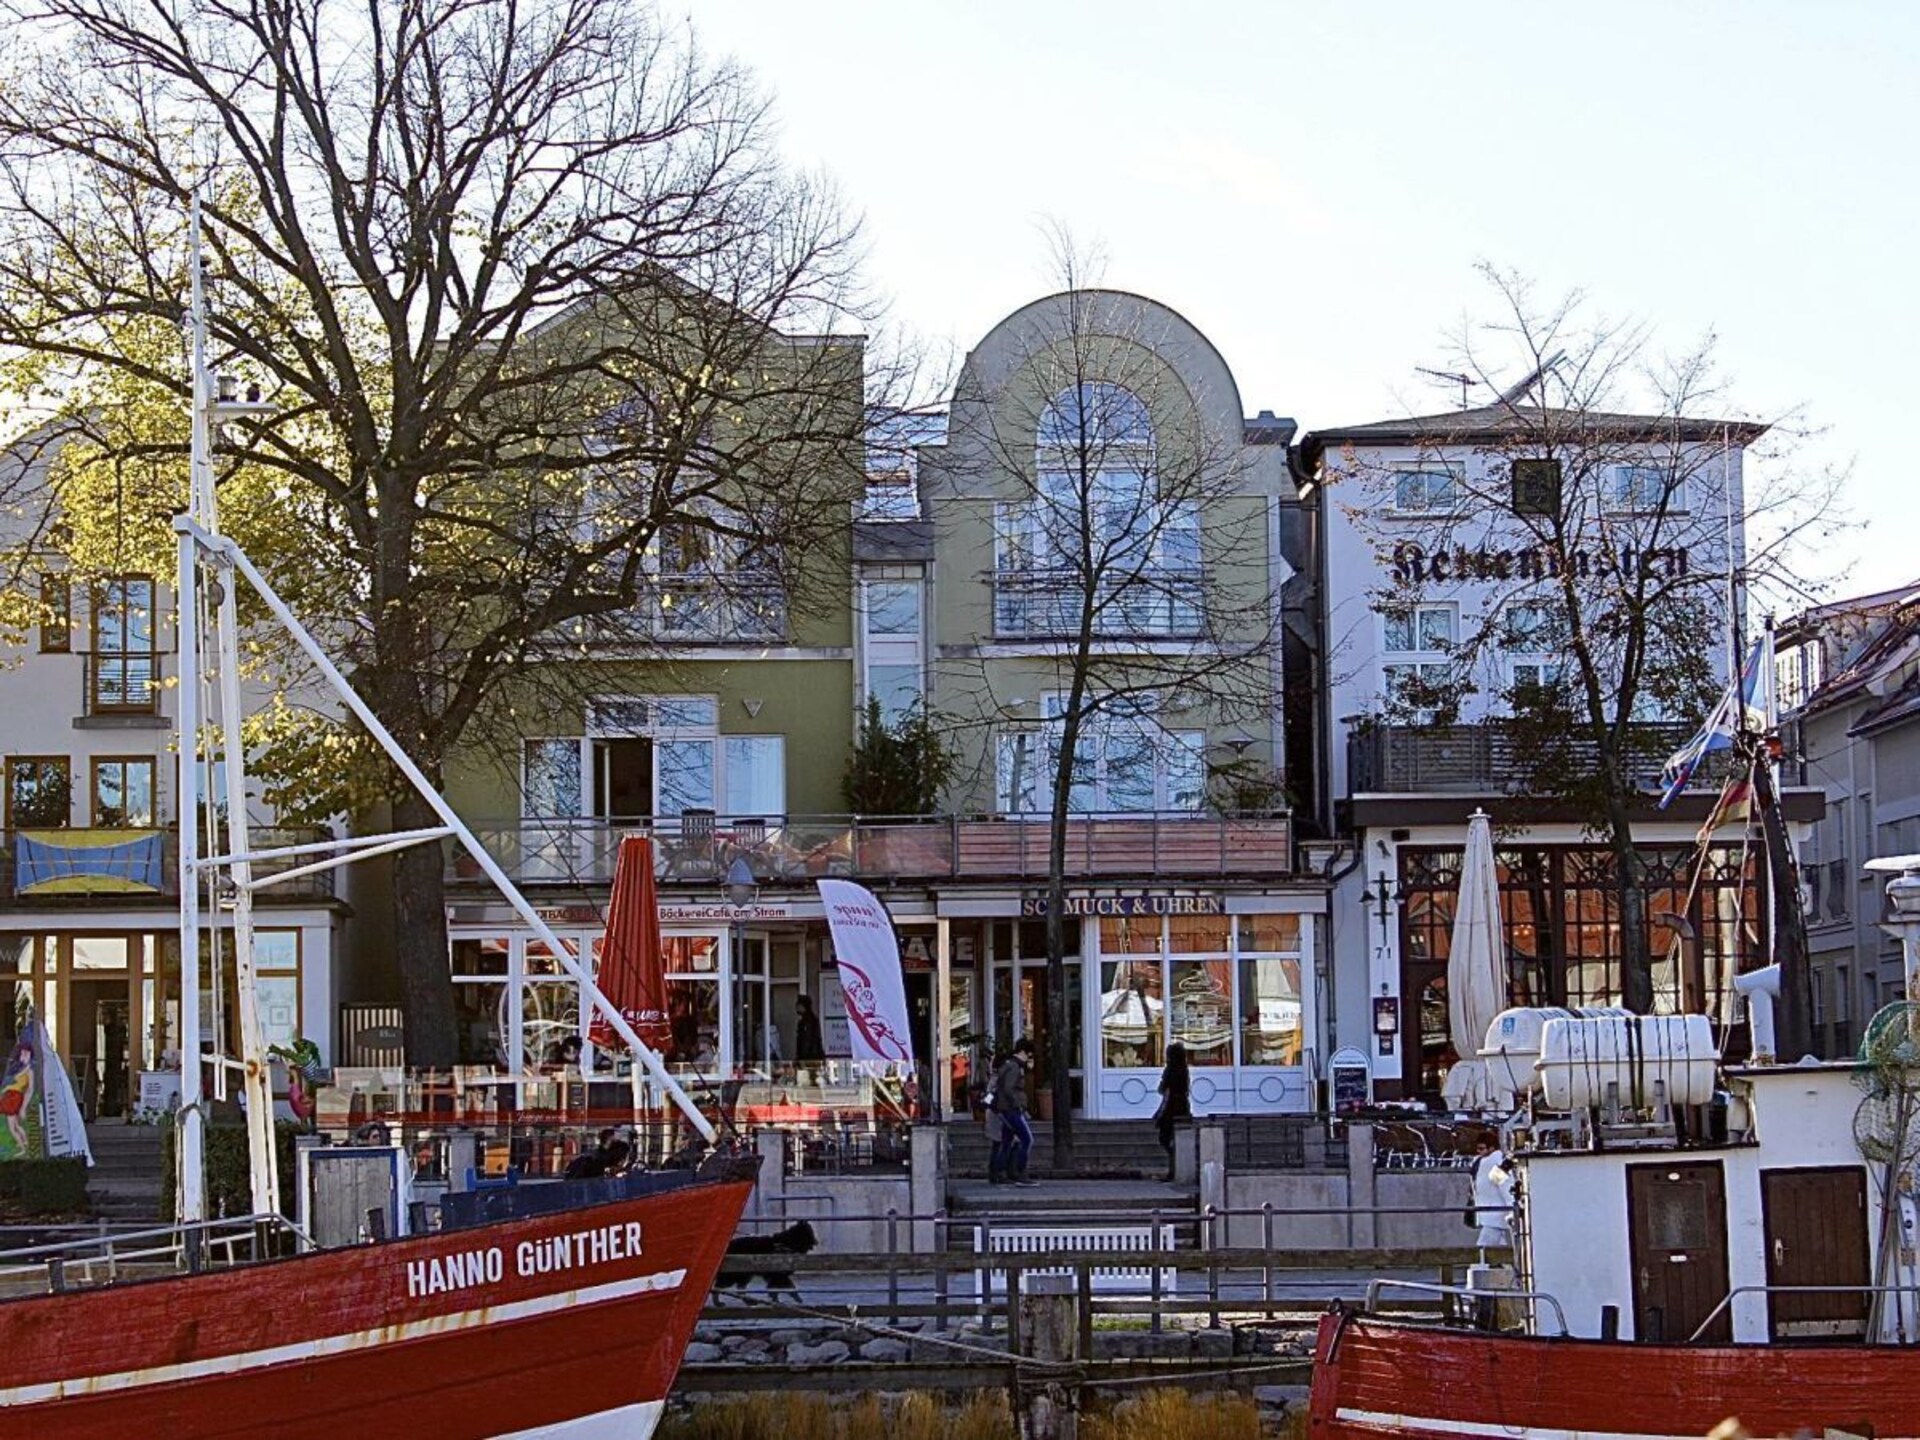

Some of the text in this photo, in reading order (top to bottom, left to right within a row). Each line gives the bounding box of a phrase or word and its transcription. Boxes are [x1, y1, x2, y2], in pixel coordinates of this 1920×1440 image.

[754, 906, 786, 918] Strom
[1023, 896, 1221, 915] SCMUCK & UHREN
[1375, 946, 1392, 960] 71
[407, 1247, 503, 1297] HANNO
